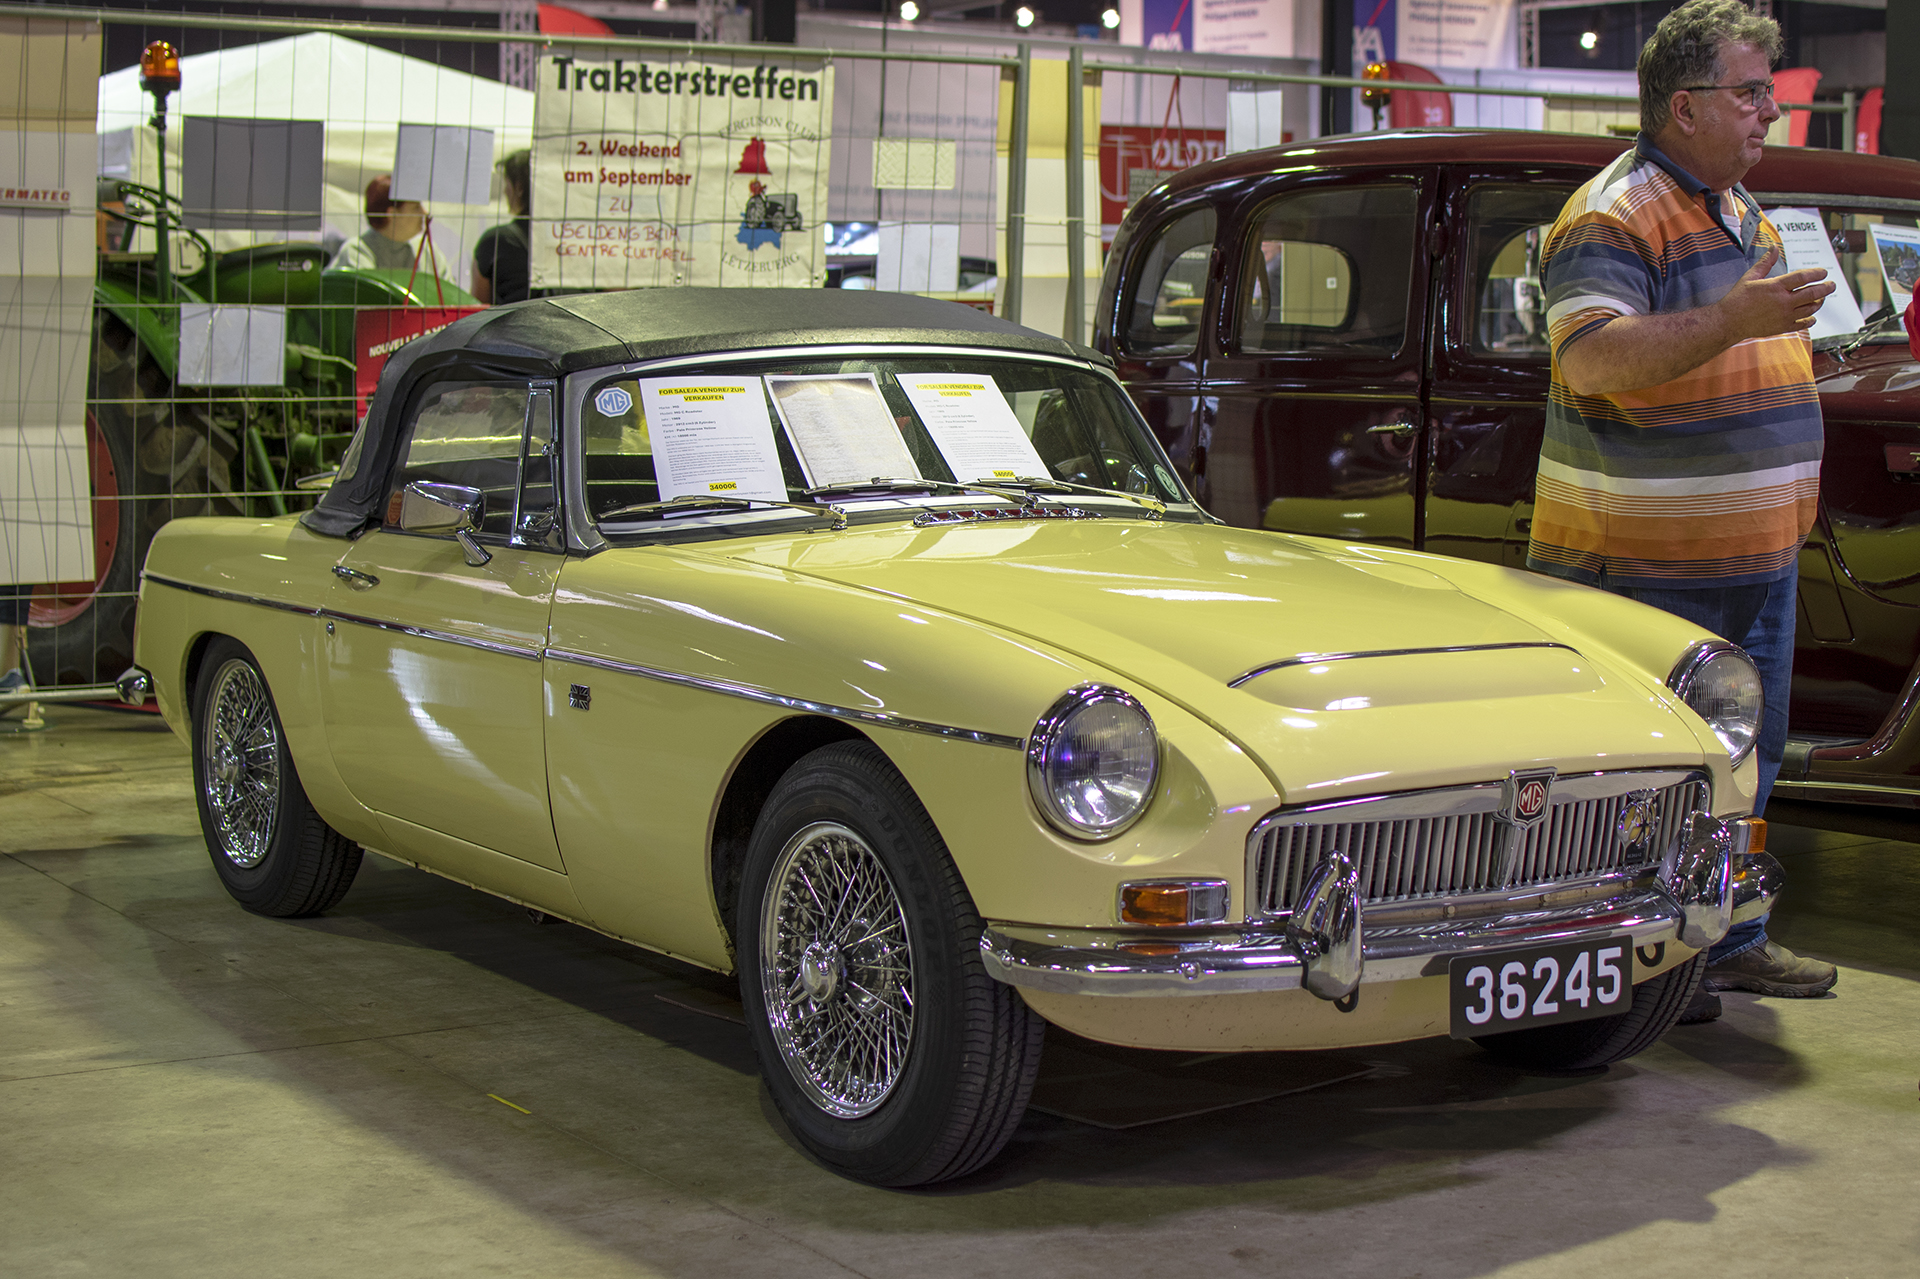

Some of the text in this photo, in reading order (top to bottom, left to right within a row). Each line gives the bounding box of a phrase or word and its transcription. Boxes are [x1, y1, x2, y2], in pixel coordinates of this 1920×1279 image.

[553, 57, 819, 101] Trakterstreffen
[718, 116, 783, 139] FERGUSON
[786, 121, 817, 143] CLUB
[576, 140, 681, 158] 2. Weekend
[564, 168, 692, 187] am September
[608, 196, 633, 212] ZU
[552, 223, 640, 241] USELDENG
[1784, 222, 1818, 232] VENDRE
[622, 246, 696, 261] CULTUREL
[602, 393, 626, 411] MG
[1521, 785, 1542, 811] MG
[1465, 946, 1622, 1024] 36245
